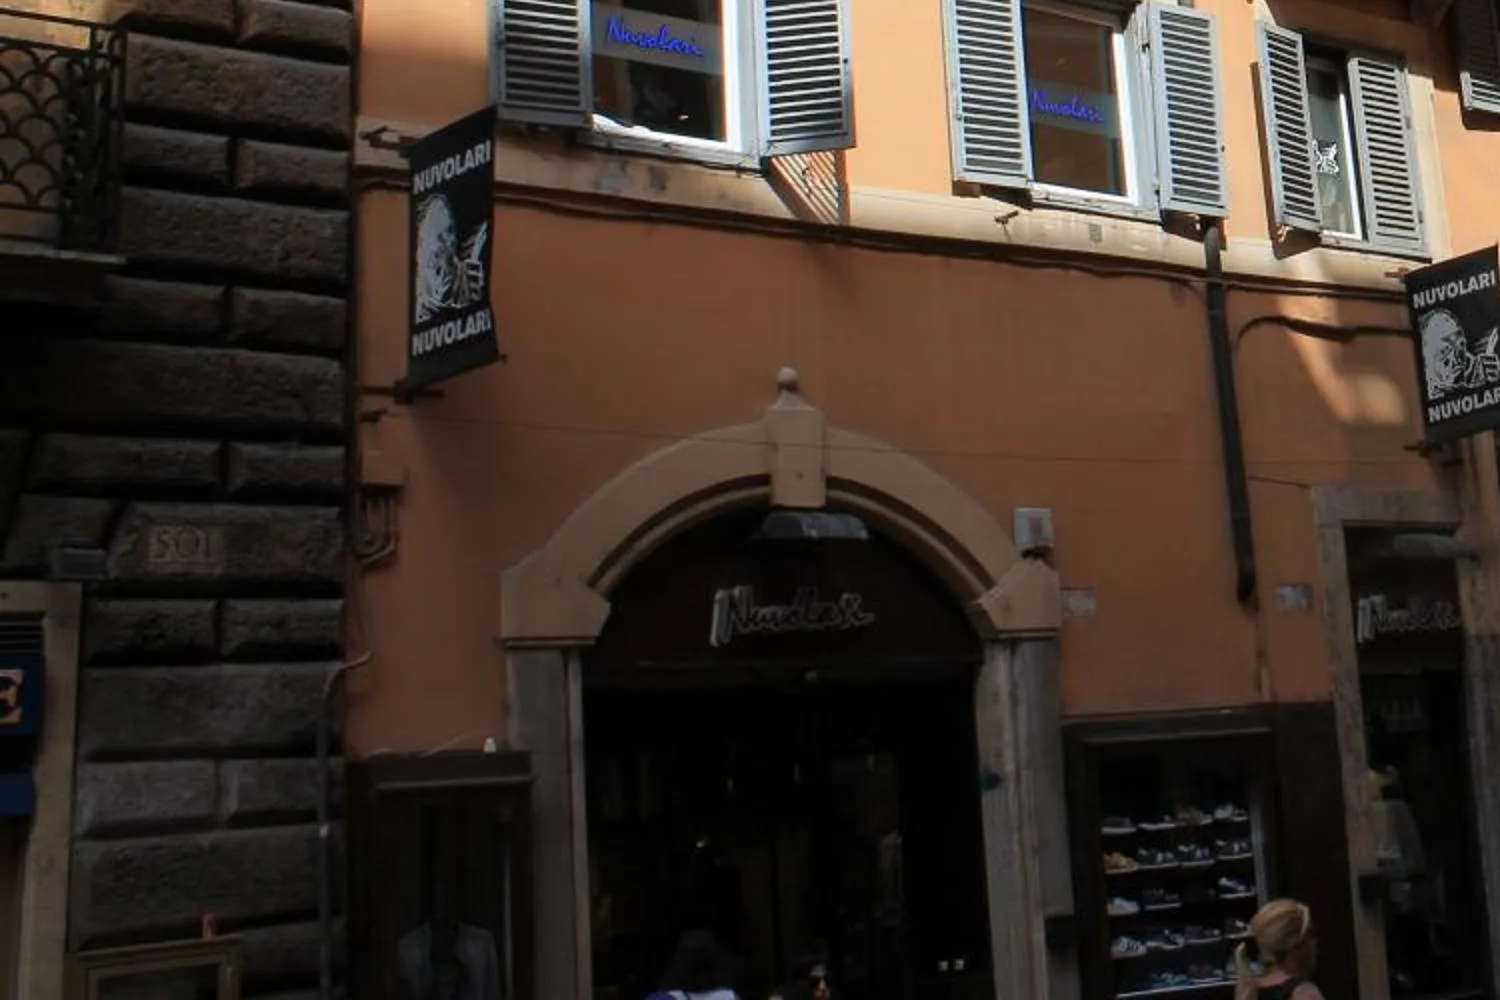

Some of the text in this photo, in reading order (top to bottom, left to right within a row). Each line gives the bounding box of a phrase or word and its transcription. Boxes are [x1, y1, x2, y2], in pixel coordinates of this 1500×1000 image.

[413, 139, 492, 195] NUVOLARI
[1412, 269, 1496, 309] NUVOLARI
[412, 308, 491, 356] NUVOLARI
